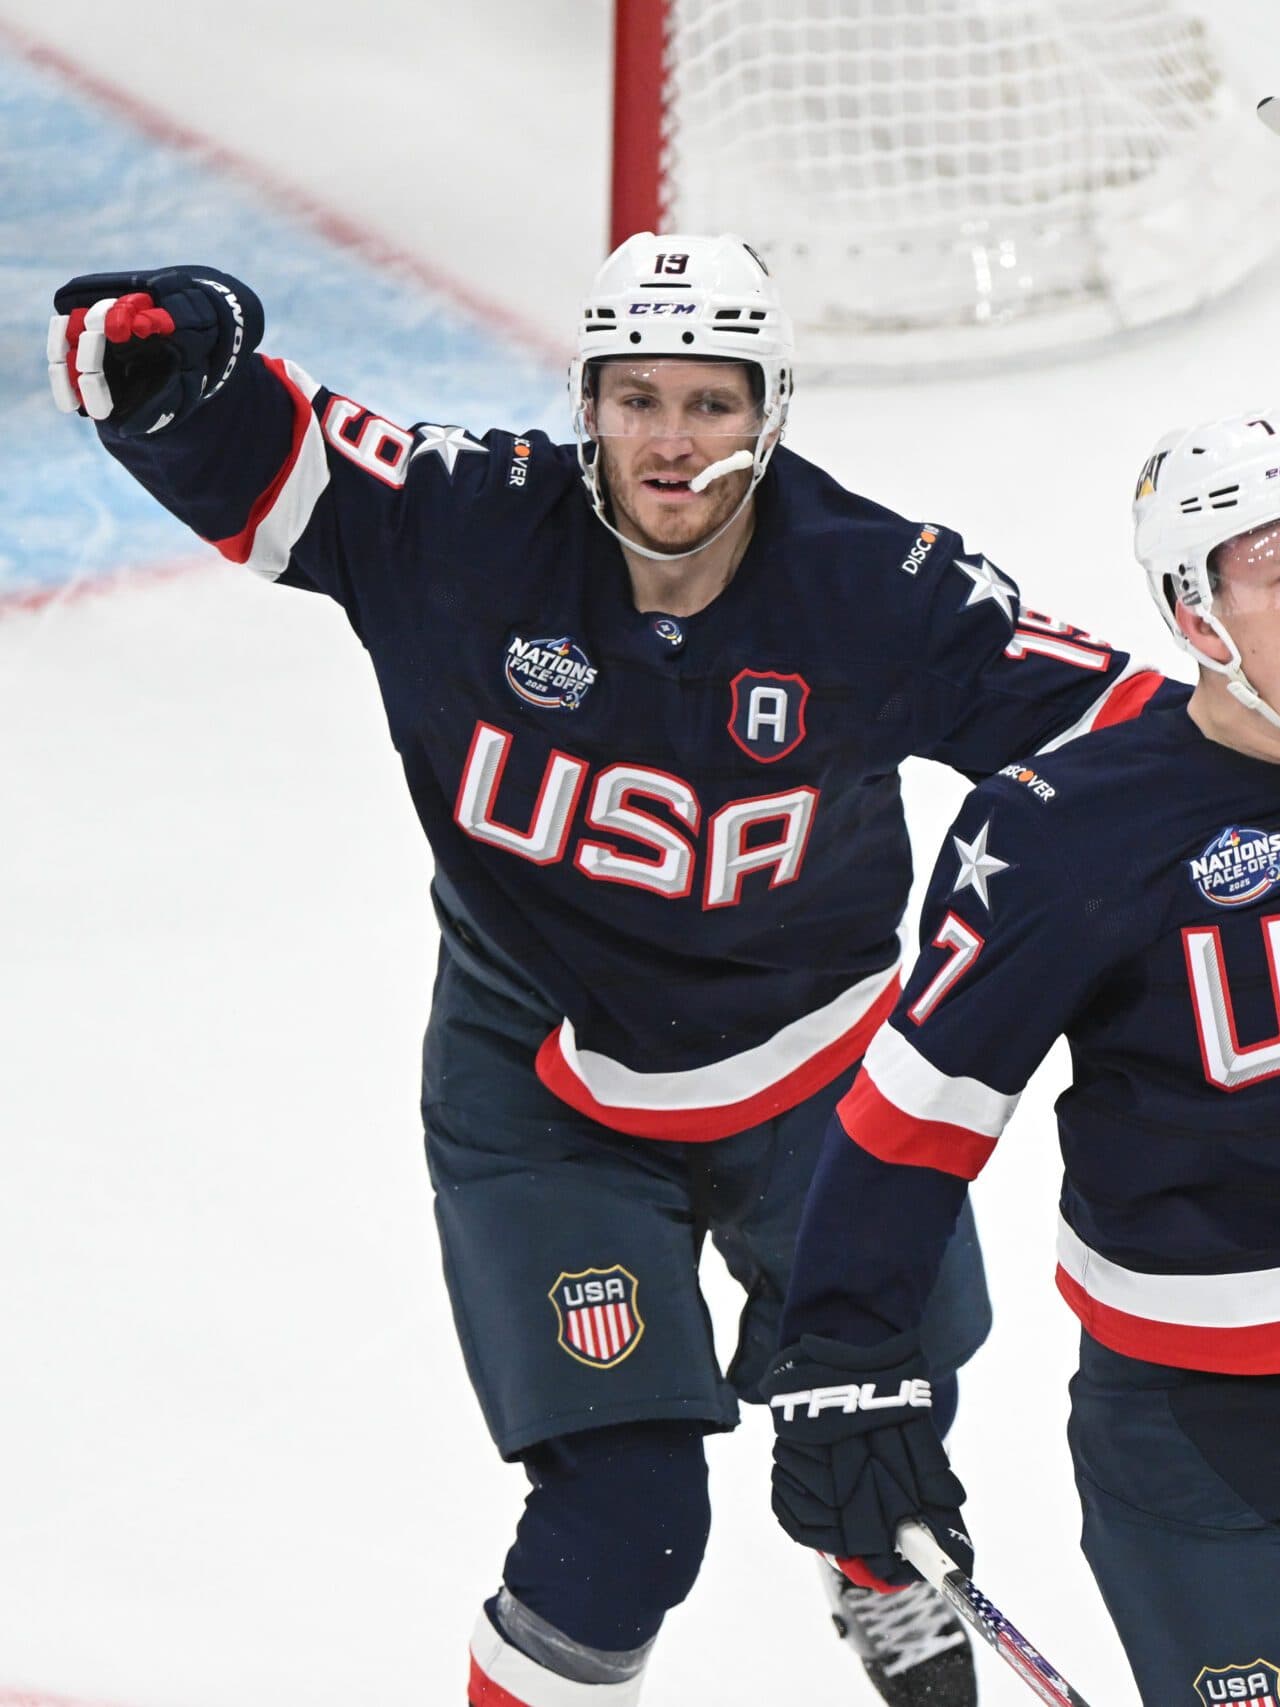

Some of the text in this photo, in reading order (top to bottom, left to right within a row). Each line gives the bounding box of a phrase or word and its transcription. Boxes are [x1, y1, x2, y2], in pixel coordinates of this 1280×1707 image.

[654, 253, 690, 275] 19
[508, 637, 599, 685] NATIONS
[509, 656, 586, 693] FACE-OFF
[747, 686, 788, 743] A
[454, 720, 821, 911] USA
[1202, 852, 1278, 891] FACE-OFF
[906, 909, 985, 1027] 7
[563, 1278, 625, 1306] USA
[770, 1379, 932, 1421] TRUE
[1206, 1672, 1270, 1700] USA
